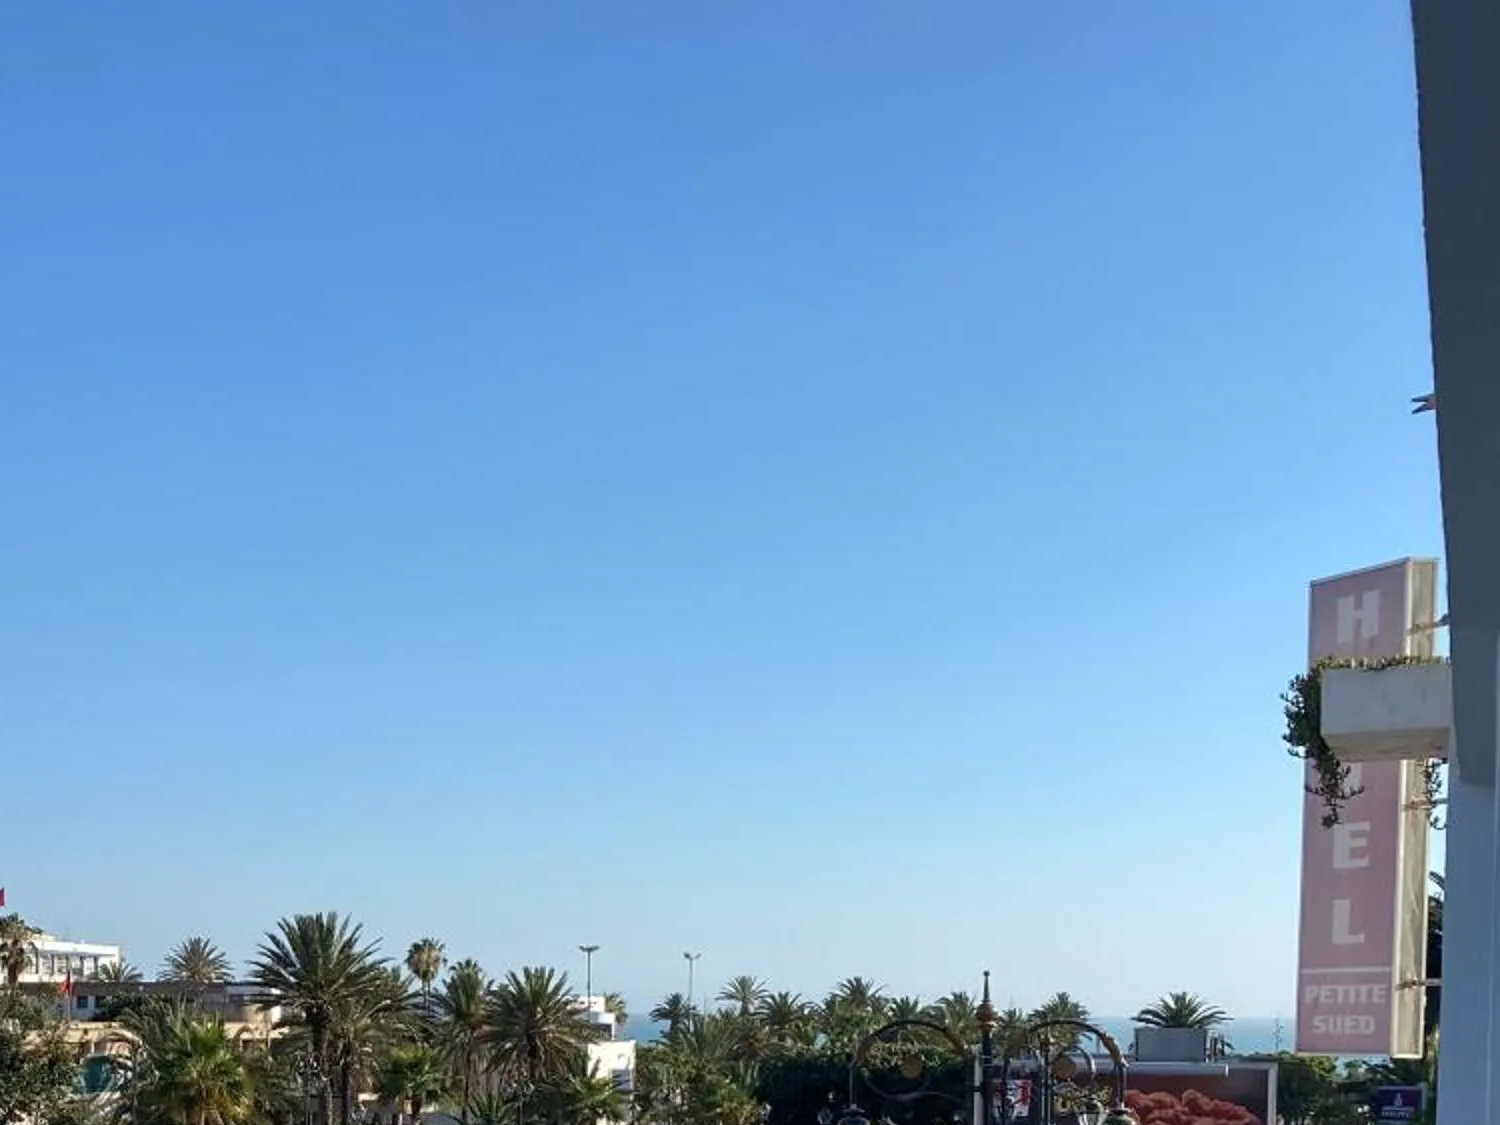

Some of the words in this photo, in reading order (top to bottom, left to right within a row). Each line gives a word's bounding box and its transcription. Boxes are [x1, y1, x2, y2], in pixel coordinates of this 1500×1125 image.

[1331, 589, 1381, 945] HEL
[1304, 985, 1387, 1004] PETITE
[1312, 1015, 1376, 1035] SUED
